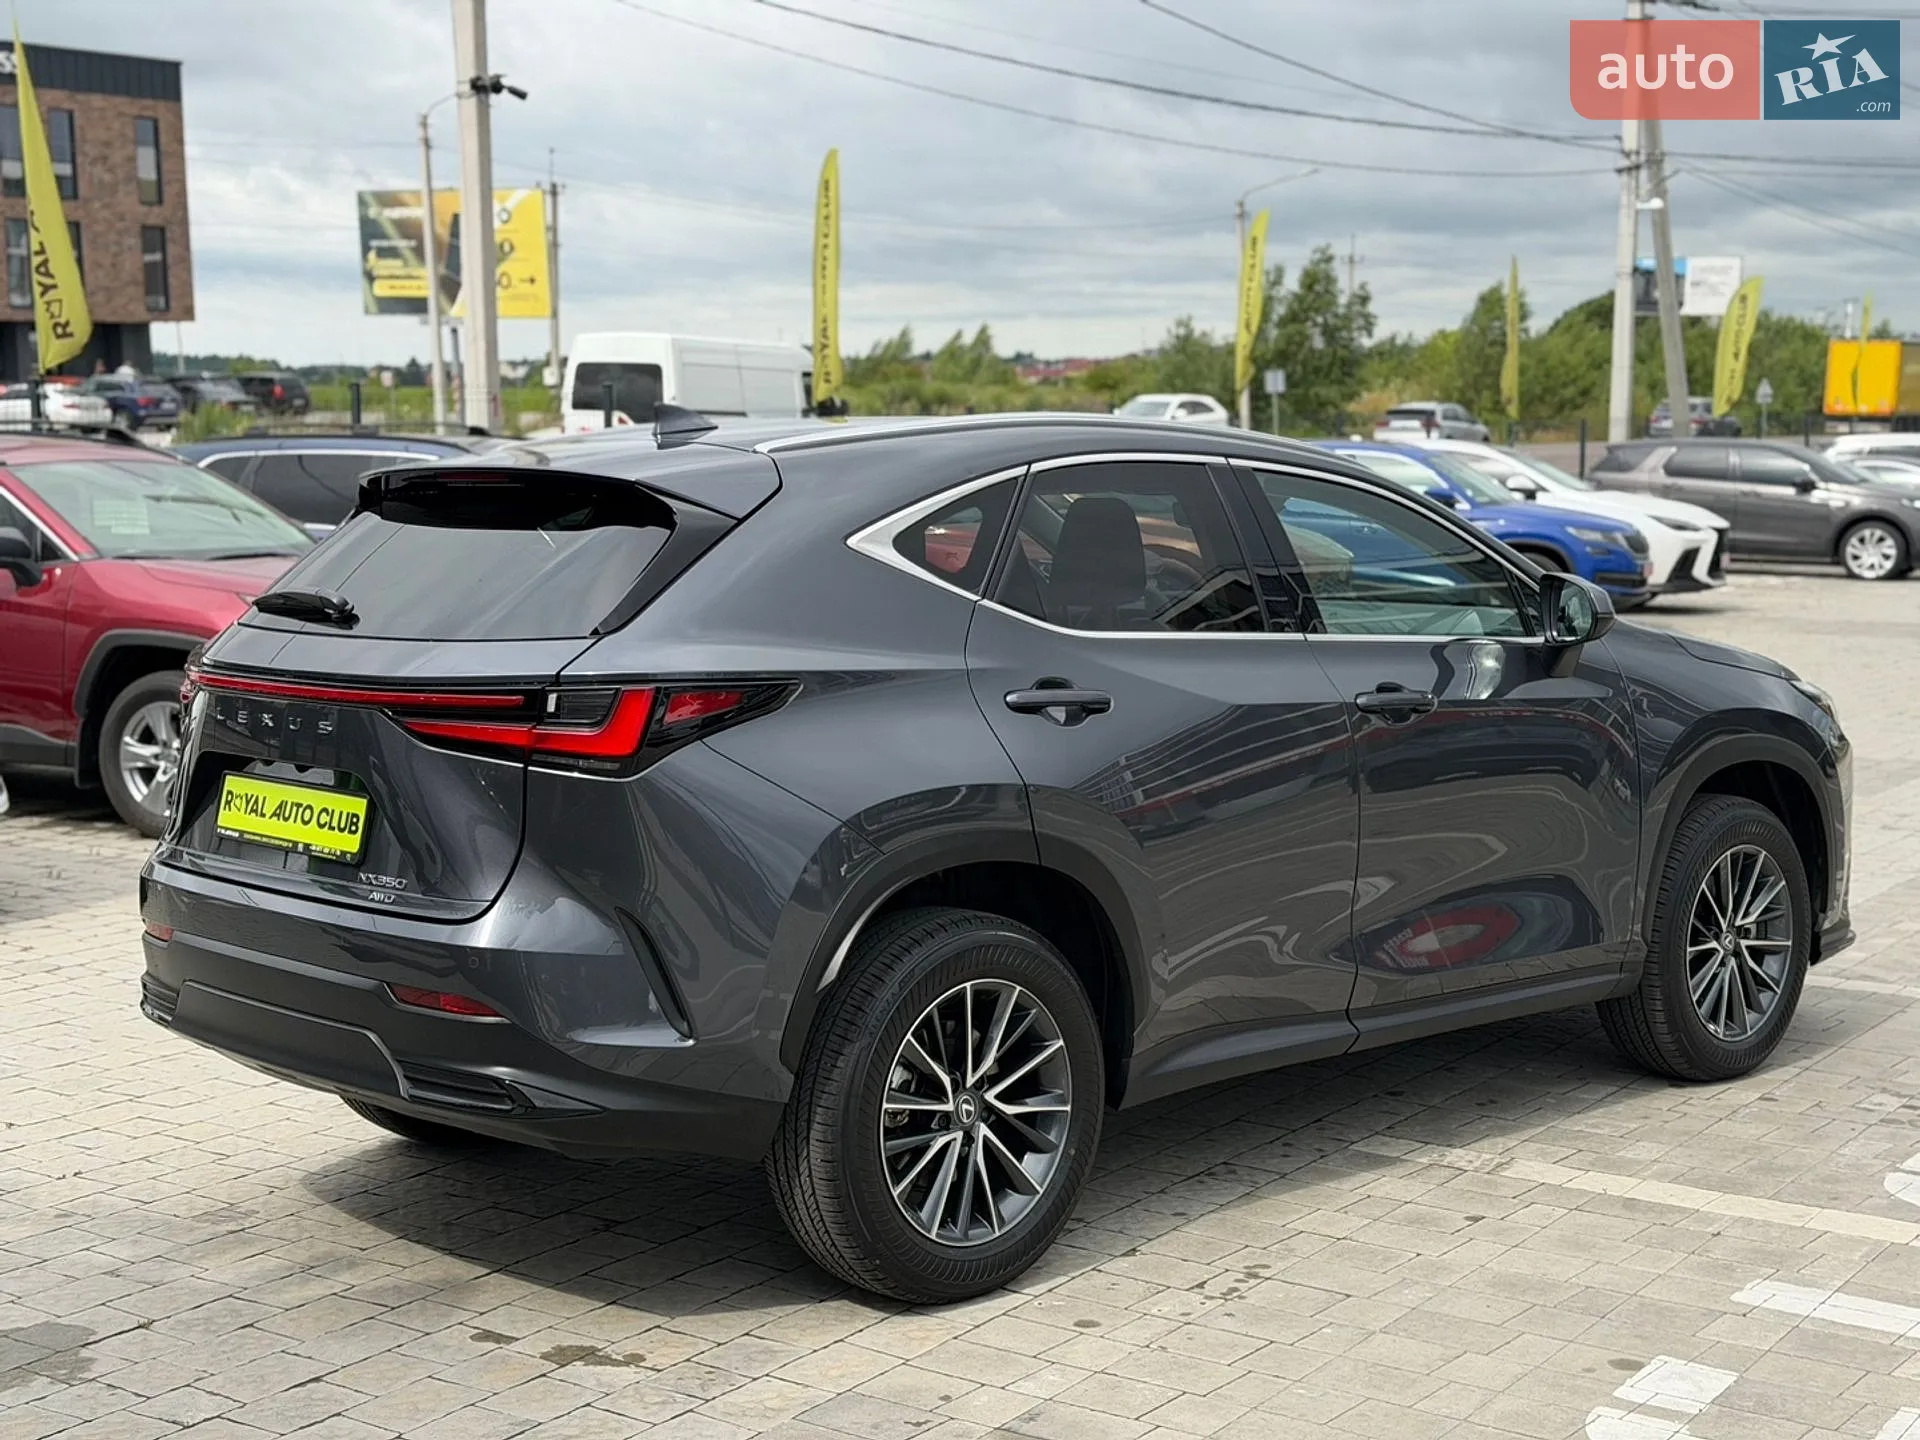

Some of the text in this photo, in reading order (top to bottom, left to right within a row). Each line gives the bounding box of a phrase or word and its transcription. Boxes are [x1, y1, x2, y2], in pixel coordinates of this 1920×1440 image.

[216, 706, 333, 734] LEXUS
[269, 799, 315, 826] AUTO
[316, 807, 360, 835] CLUB
